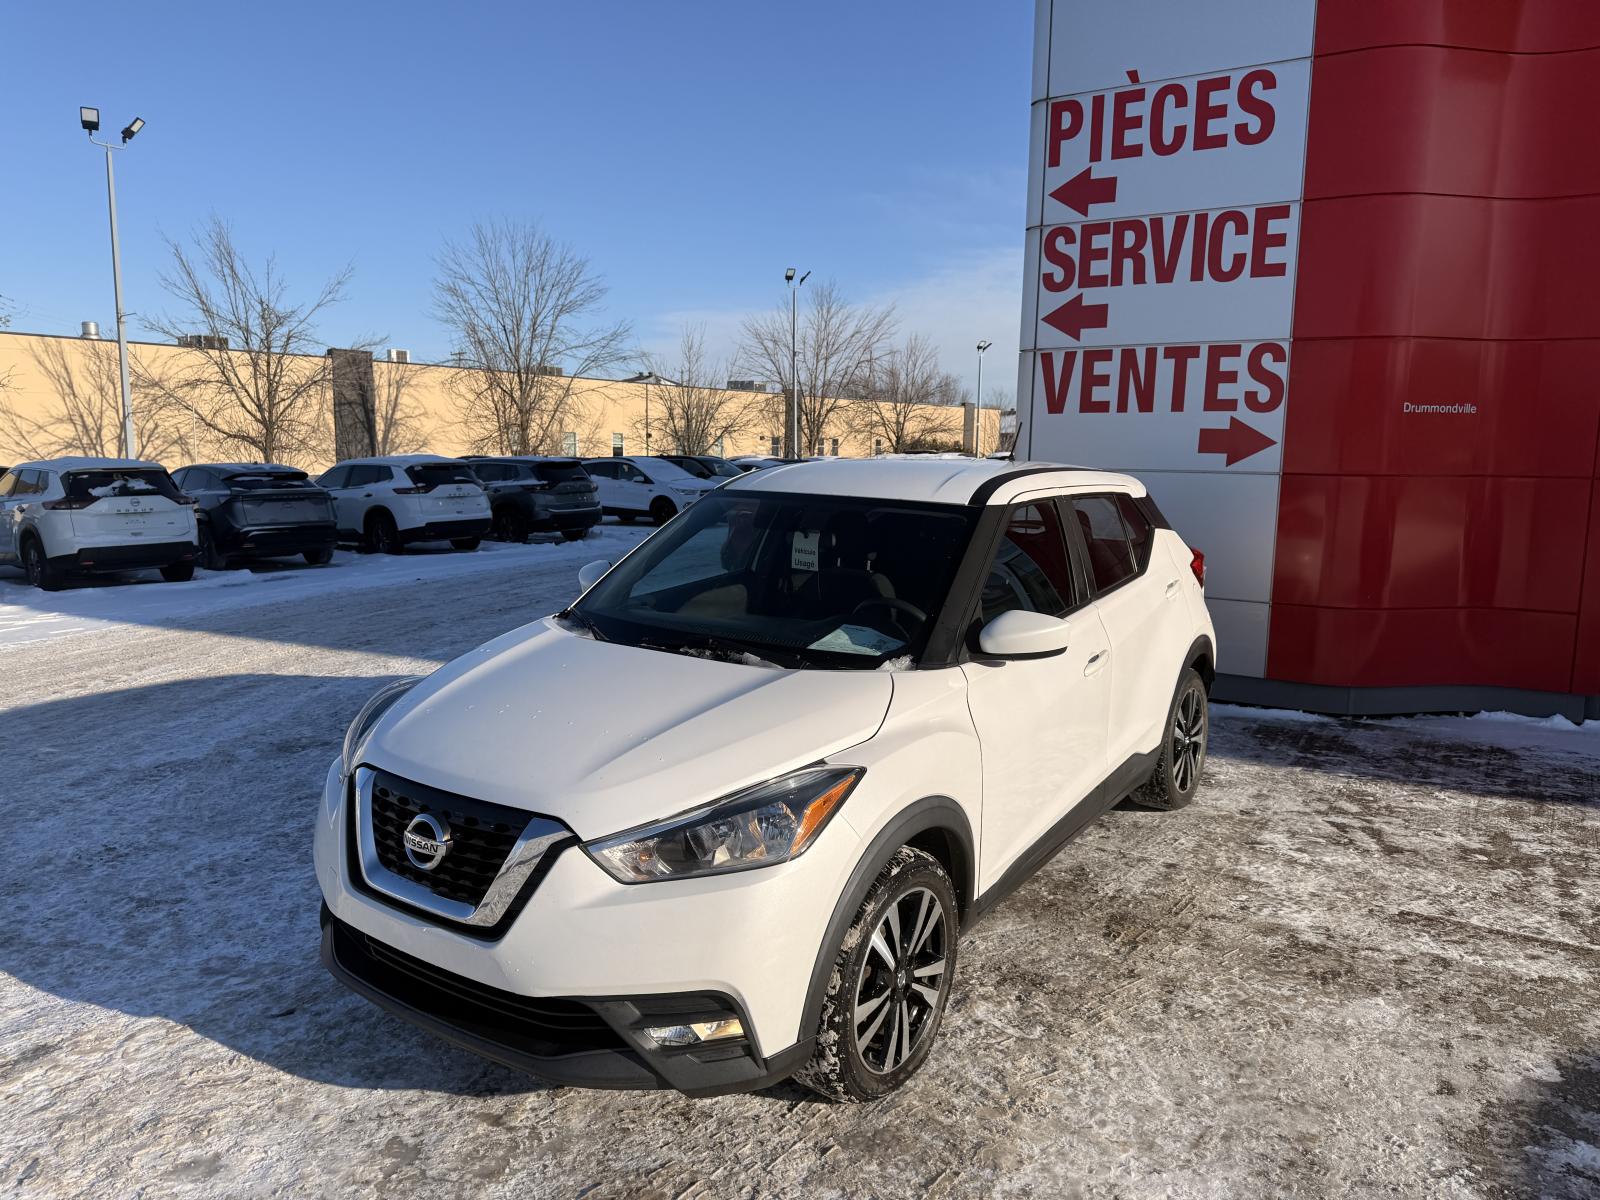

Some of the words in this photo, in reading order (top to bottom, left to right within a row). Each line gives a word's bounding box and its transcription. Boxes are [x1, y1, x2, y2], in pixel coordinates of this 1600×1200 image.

[1048, 69, 1277, 168] PIÈCES
[1042, 205, 1291, 292] SERVICE
[1040, 342, 1287, 415] VENTES
[1403, 402, 1477, 414] Drummondville
[404, 835, 438, 853] NISSAN
